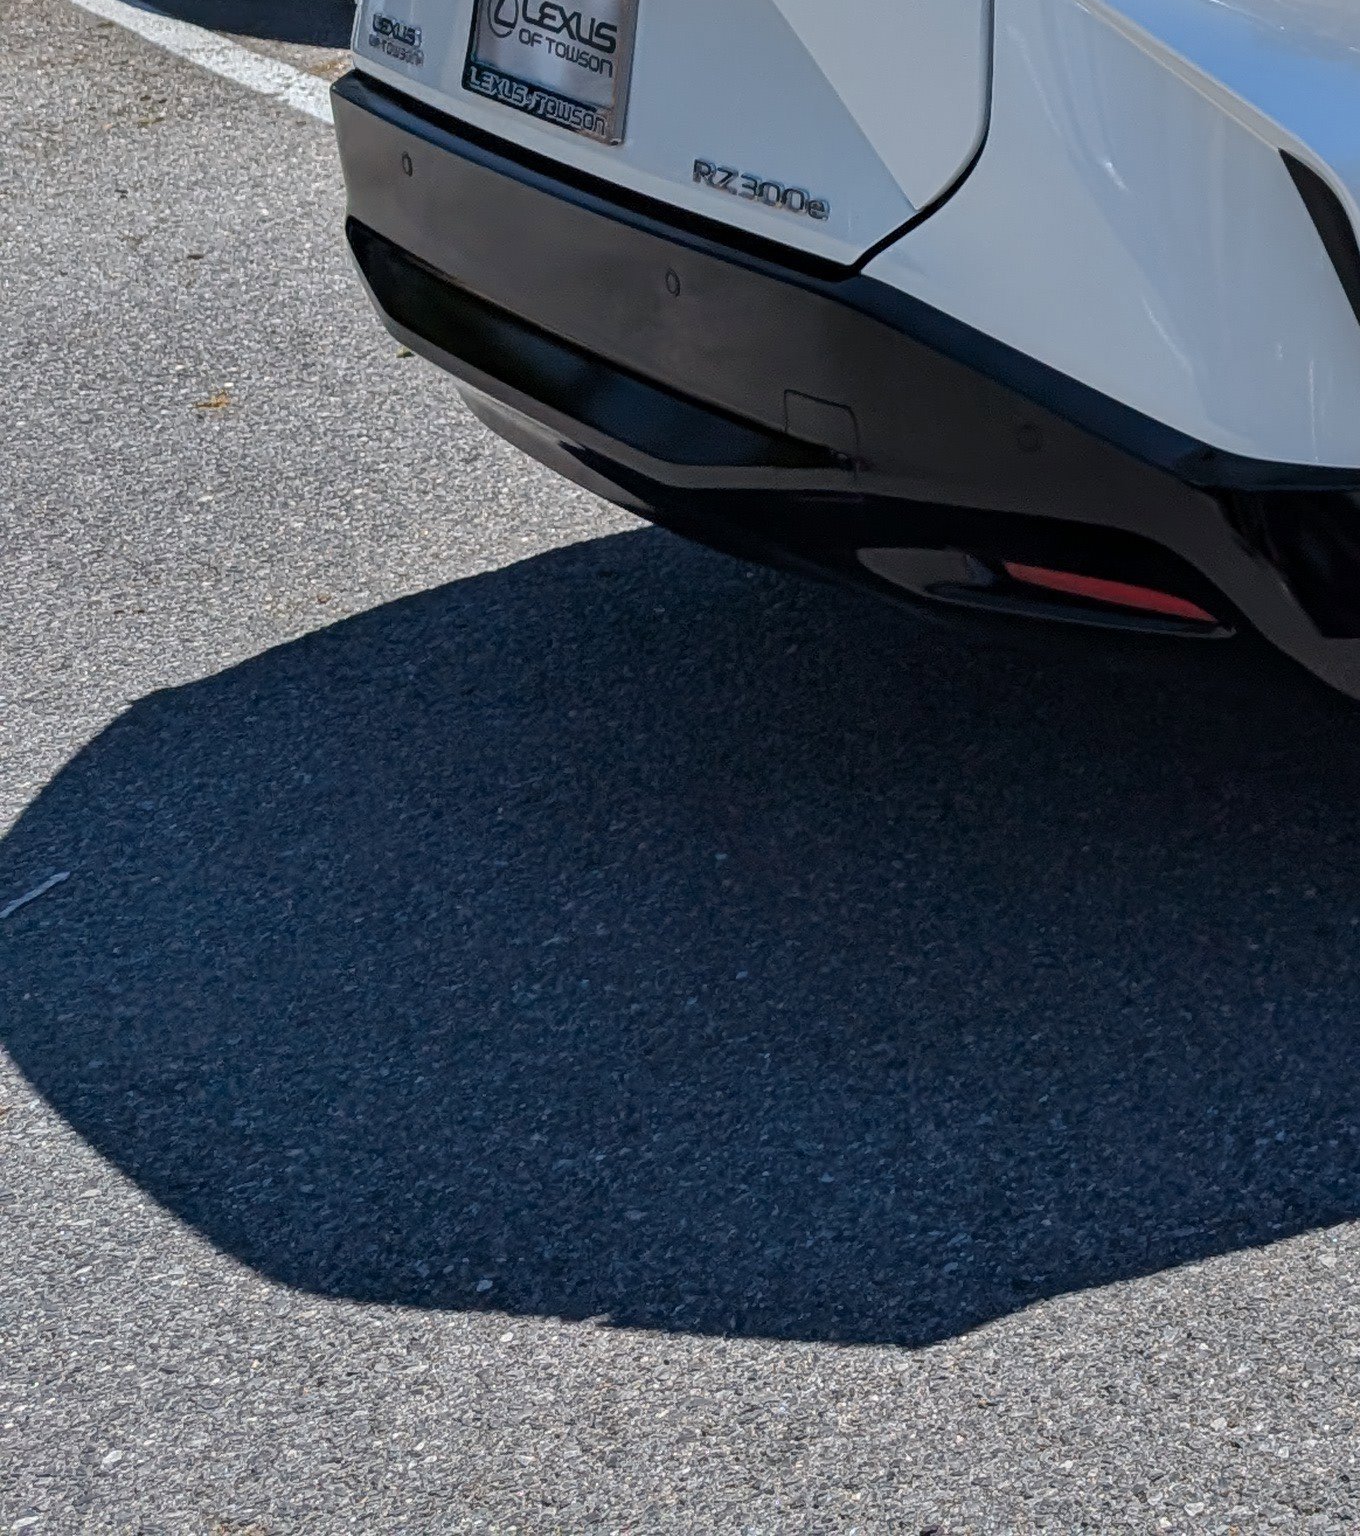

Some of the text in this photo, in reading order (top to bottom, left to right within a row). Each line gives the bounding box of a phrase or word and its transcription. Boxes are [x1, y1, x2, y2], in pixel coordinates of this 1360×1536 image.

[373, 13, 420, 46] LEXUS
[519, 28, 613, 78] OF TOWSON
[469, 65, 529, 107] LEXUS
[536, 93, 608, 136] TOWSON
